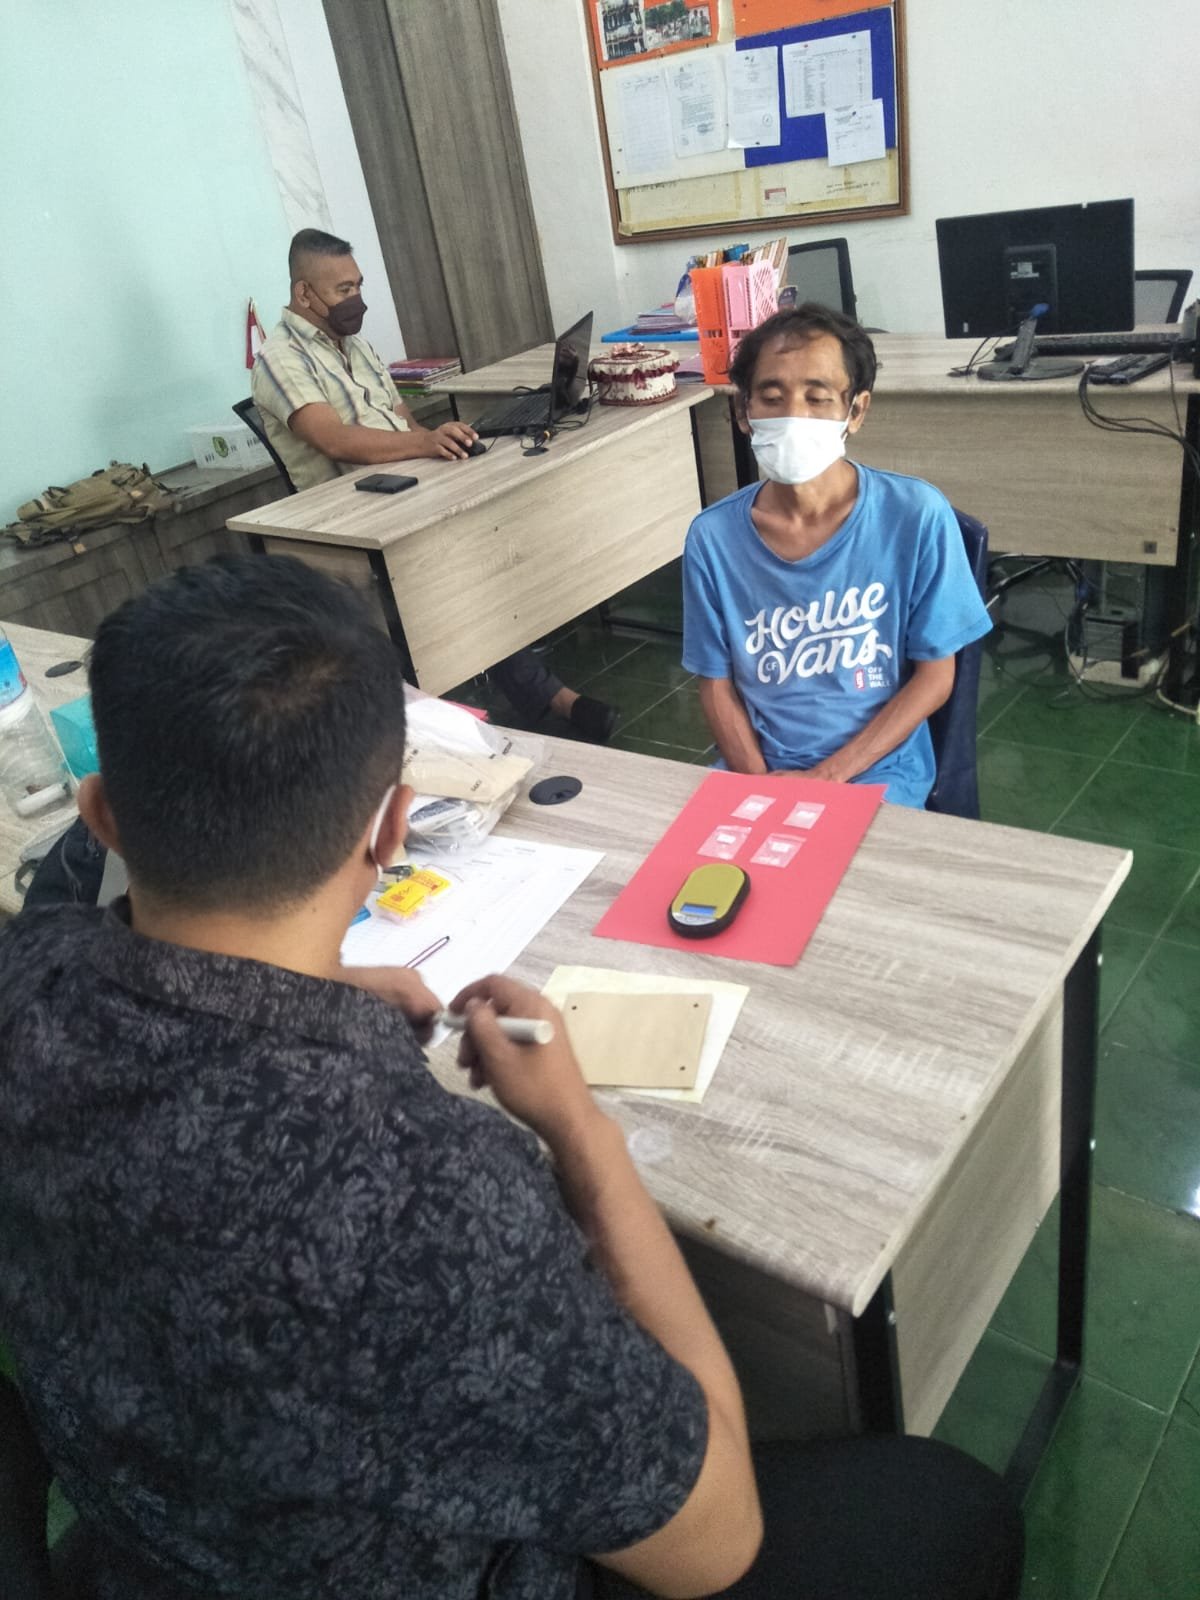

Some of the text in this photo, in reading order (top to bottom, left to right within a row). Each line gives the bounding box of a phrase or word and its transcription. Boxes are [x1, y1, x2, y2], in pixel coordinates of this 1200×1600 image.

[744, 582, 889, 655] House
[757, 622, 893, 685] Vans
[869, 673, 883, 681] THE
